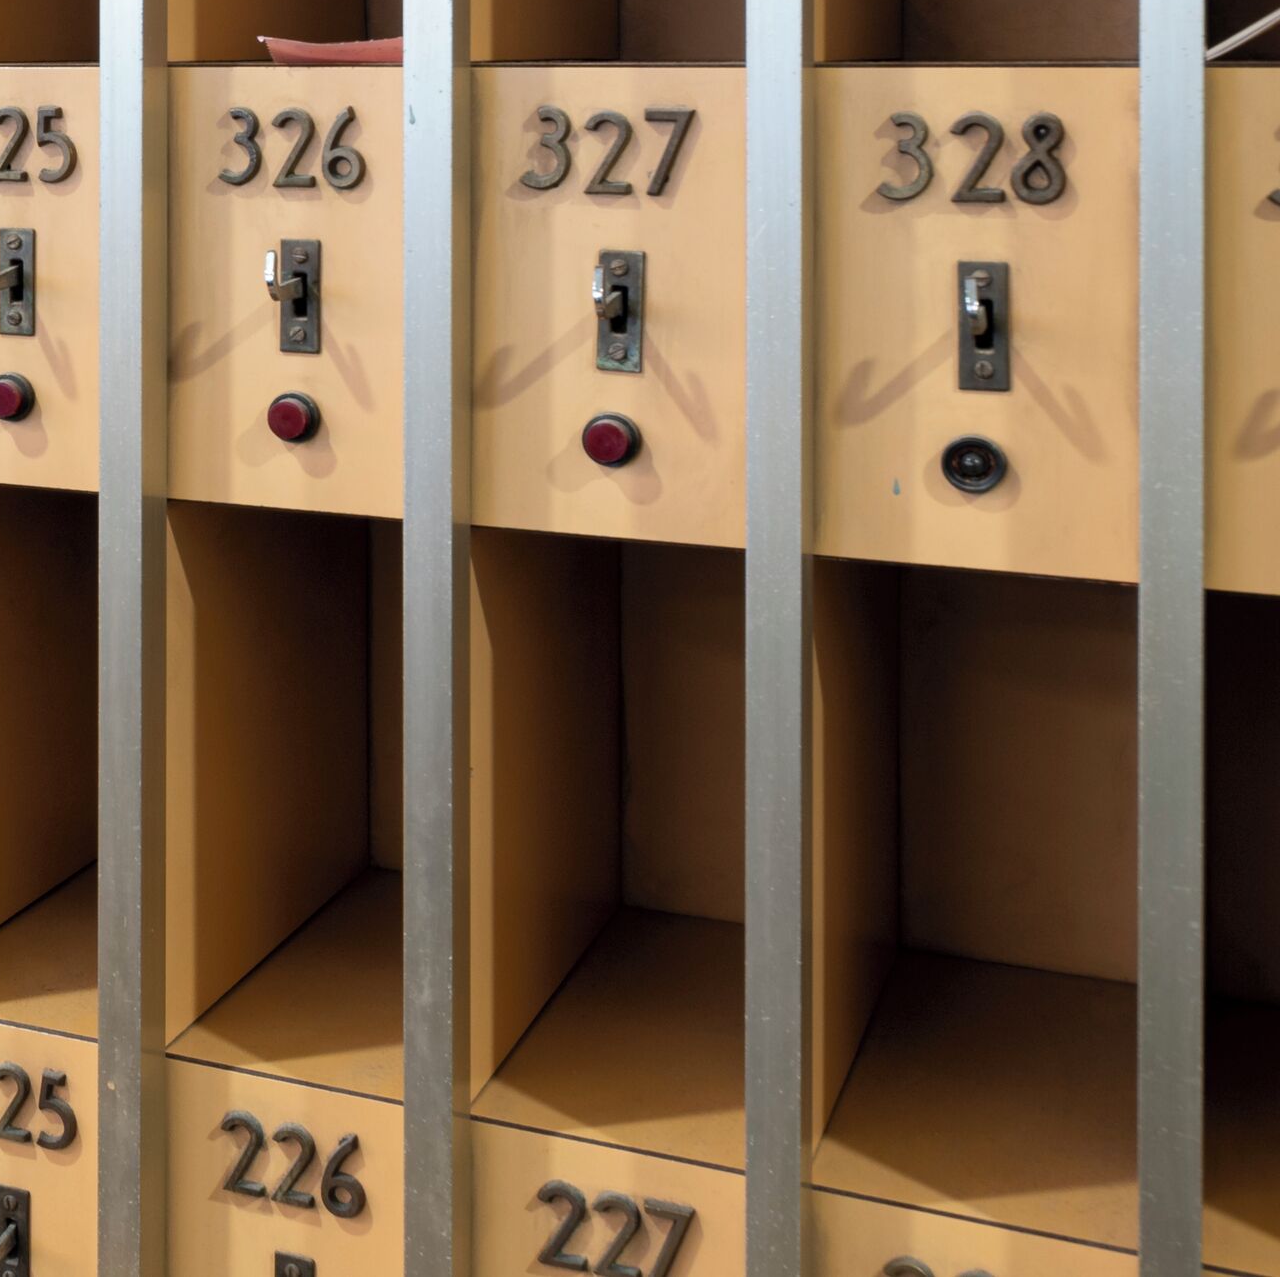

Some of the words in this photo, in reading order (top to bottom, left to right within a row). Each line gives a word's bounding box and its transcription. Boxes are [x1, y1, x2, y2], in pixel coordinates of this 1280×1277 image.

[218, 106, 366, 190] 326
[520, 106, 696, 197] 327
[876, 111, 1066, 205] 328
[221, 1109, 366, 1219] 226
[537, 1178, 696, 1277] 227
